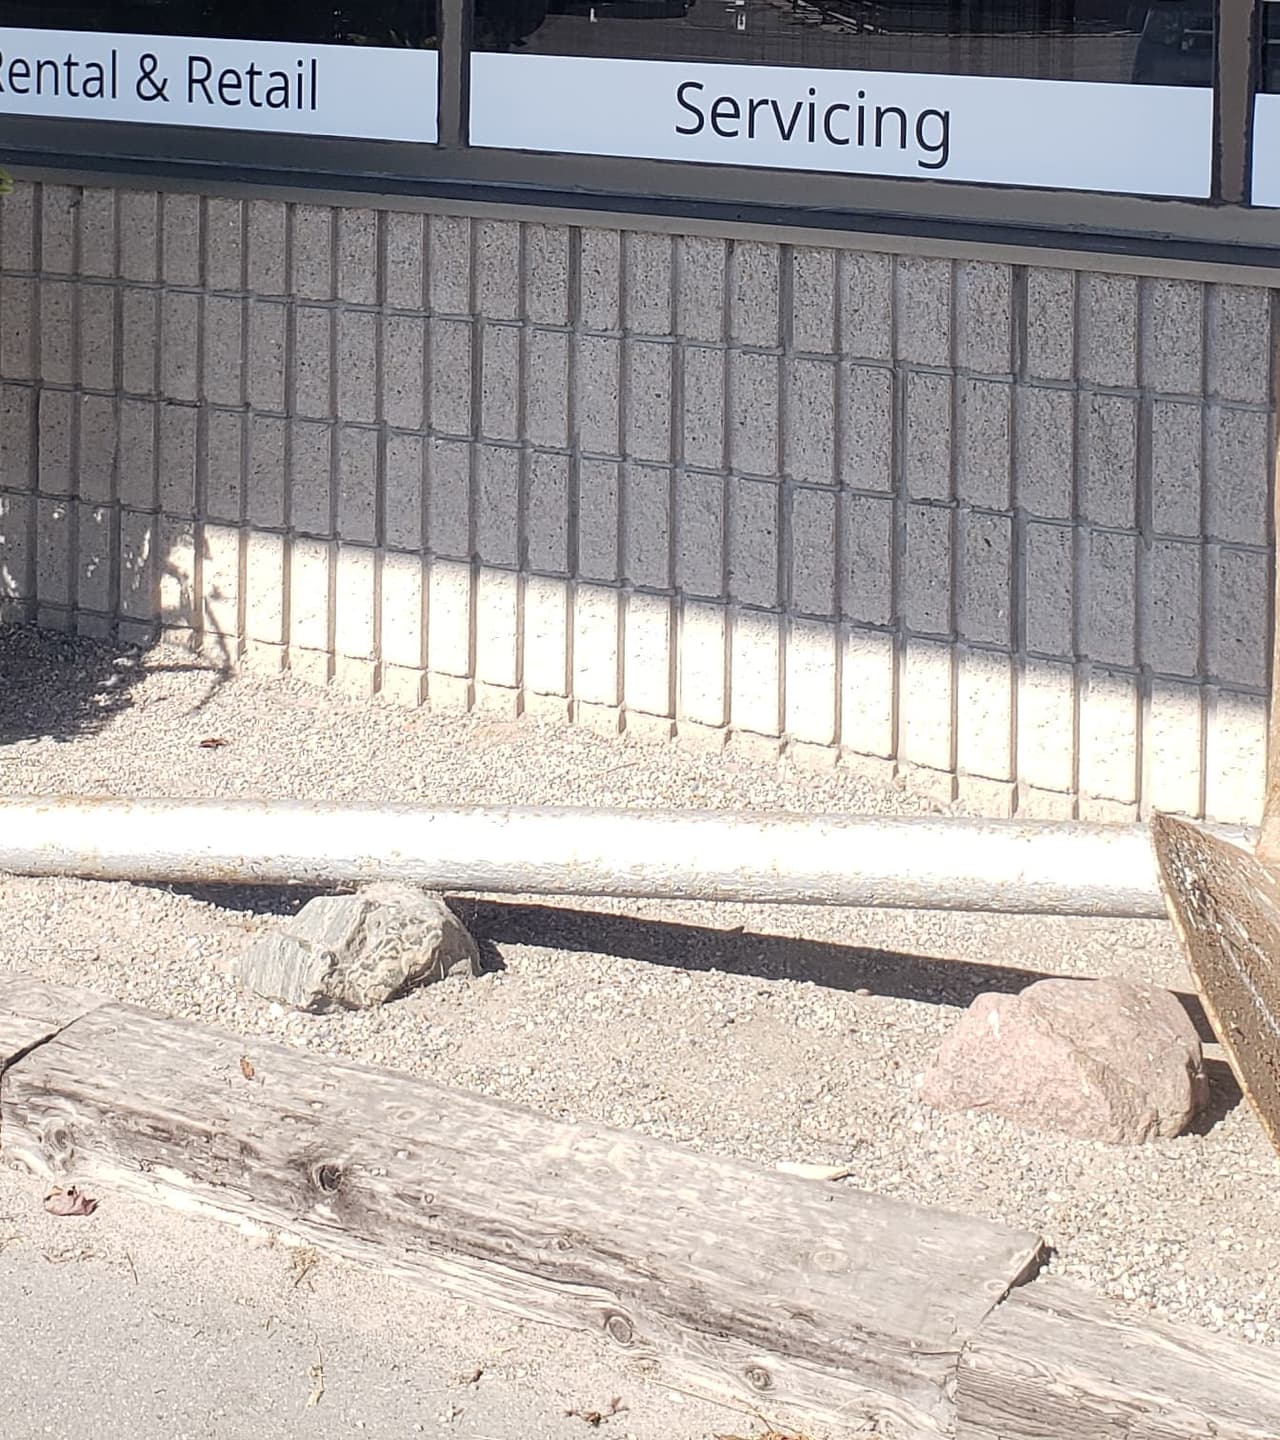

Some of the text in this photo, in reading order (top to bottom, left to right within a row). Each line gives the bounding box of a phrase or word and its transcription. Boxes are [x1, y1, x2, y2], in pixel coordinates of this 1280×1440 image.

[135, 53, 170, 103] &
[187, 54, 318, 111] Retail
[673, 80, 952, 170] Servicing
